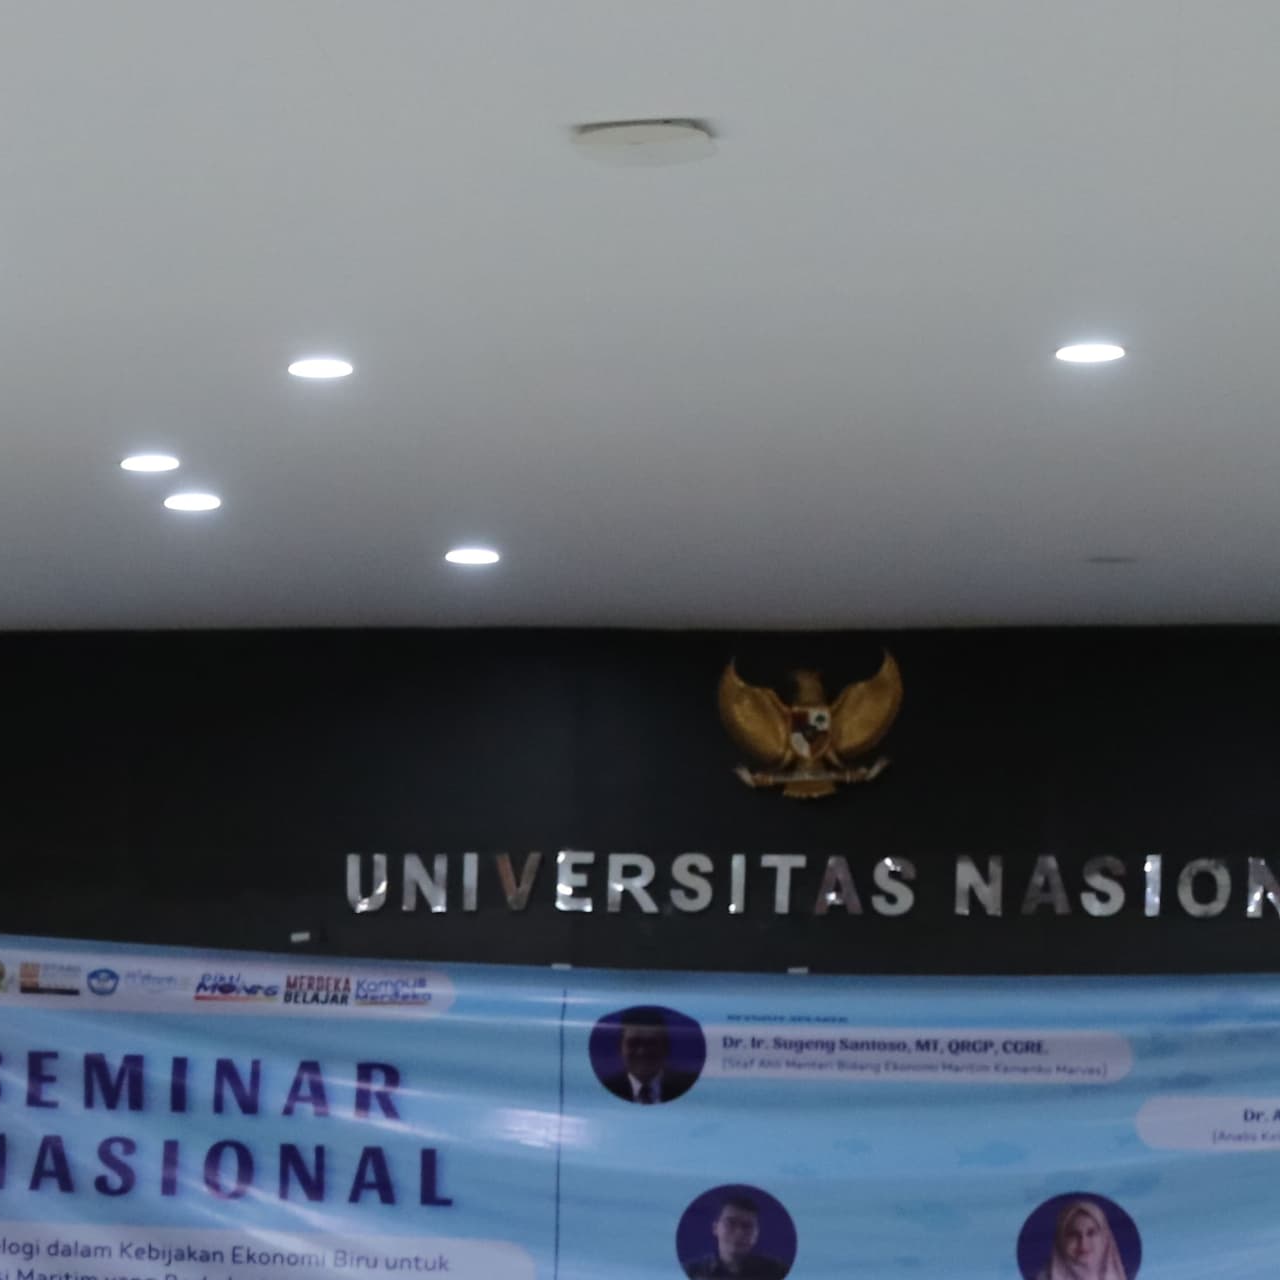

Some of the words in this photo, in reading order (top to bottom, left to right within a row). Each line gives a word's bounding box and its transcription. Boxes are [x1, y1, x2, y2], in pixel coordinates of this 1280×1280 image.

[346, 849, 916, 917] UNIVERSITAS
[953, 852, 1280, 919] NASION
[286, 975, 352, 993] MERDEKA
[355, 977, 428, 994] Kampus
[283, 991, 350, 1004] BELAJAR
[722, 1035, 747, 1049] Dr.
[772, 1036, 836, 1054] Sugeng
[839, 1037, 912, 1054] Santoso,
[836, 1059, 881, 1074] Bidang
[47, 1240, 113, 1259] dalam
[119, 1242, 225, 1267] Kebijakan
[231, 1245, 327, 1268] Ekonomi
[333, 1249, 378, 1270] Biru
[384, 1254, 449, 1272] untuk
